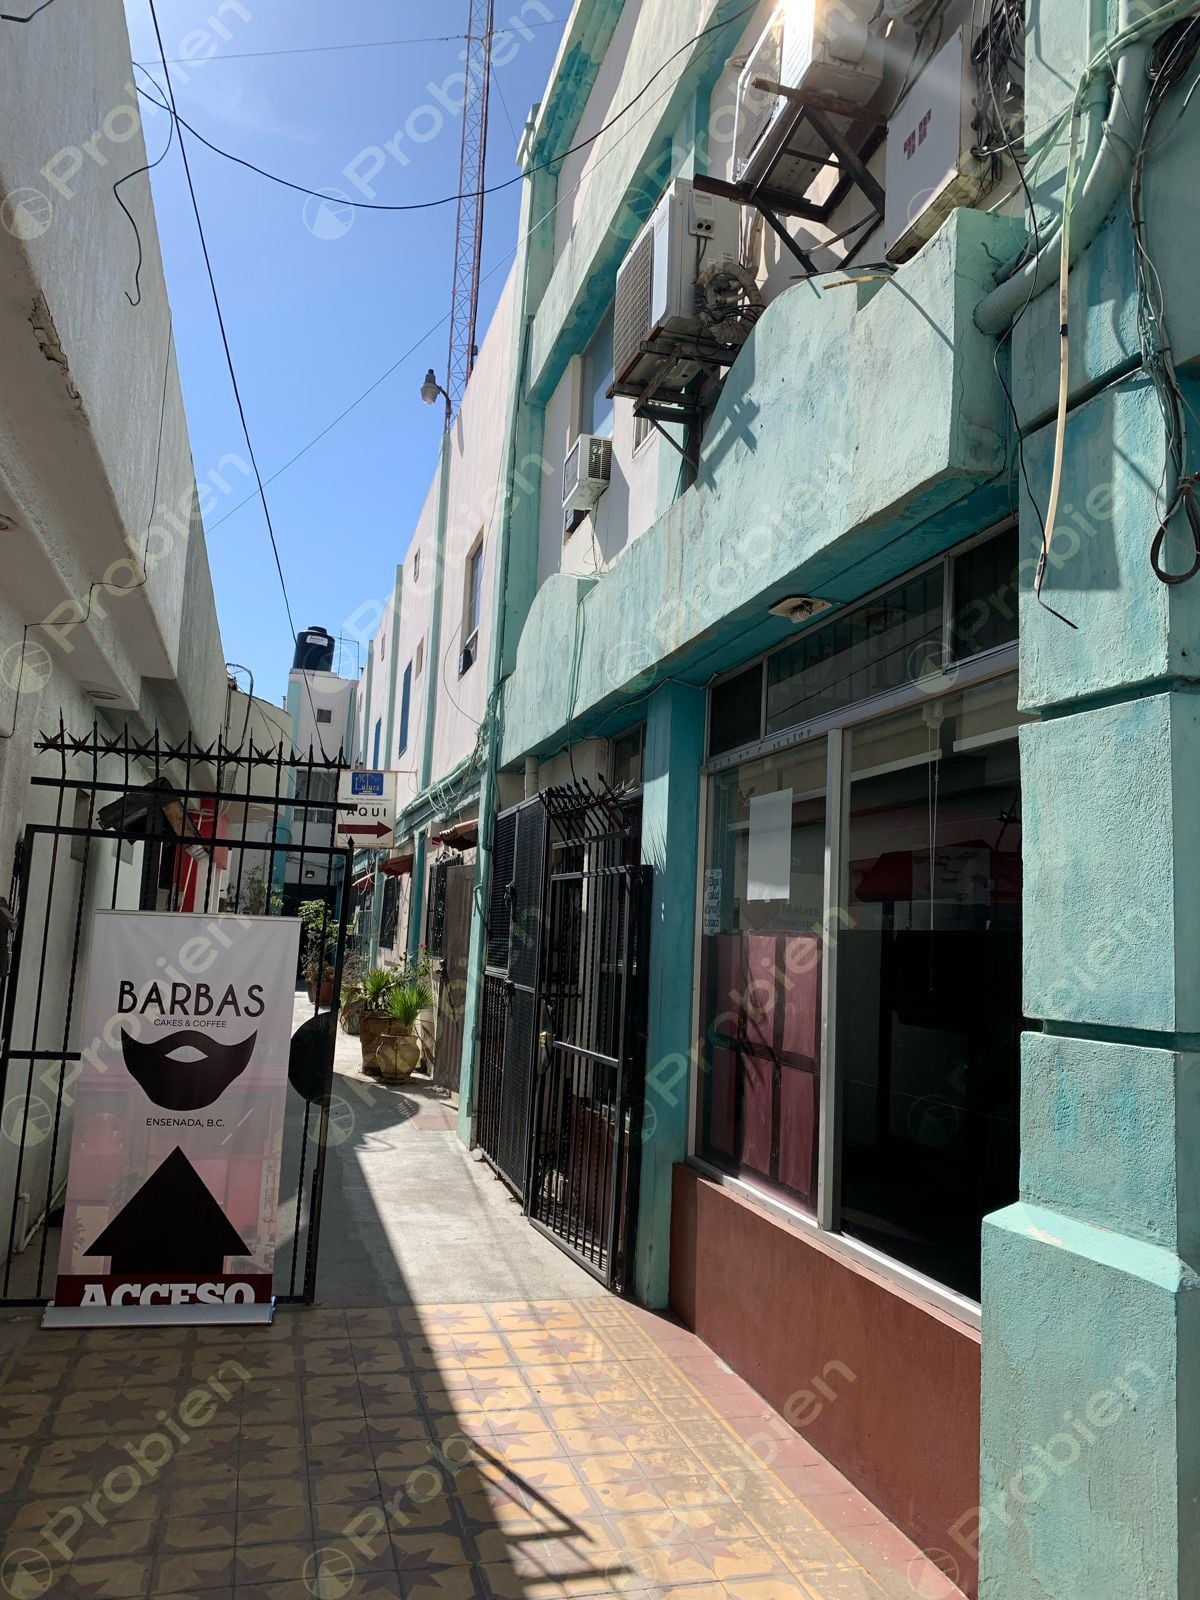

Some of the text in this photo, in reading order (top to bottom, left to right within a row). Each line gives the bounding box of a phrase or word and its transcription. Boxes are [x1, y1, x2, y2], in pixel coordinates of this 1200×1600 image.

[346, 807, 386, 817] AQUI
[117, 980, 265, 1018] BARBAS
[153, 1018, 227, 1028] CAKES & COFFEE
[146, 1117, 225, 1128] ENSENADA, B.C.
